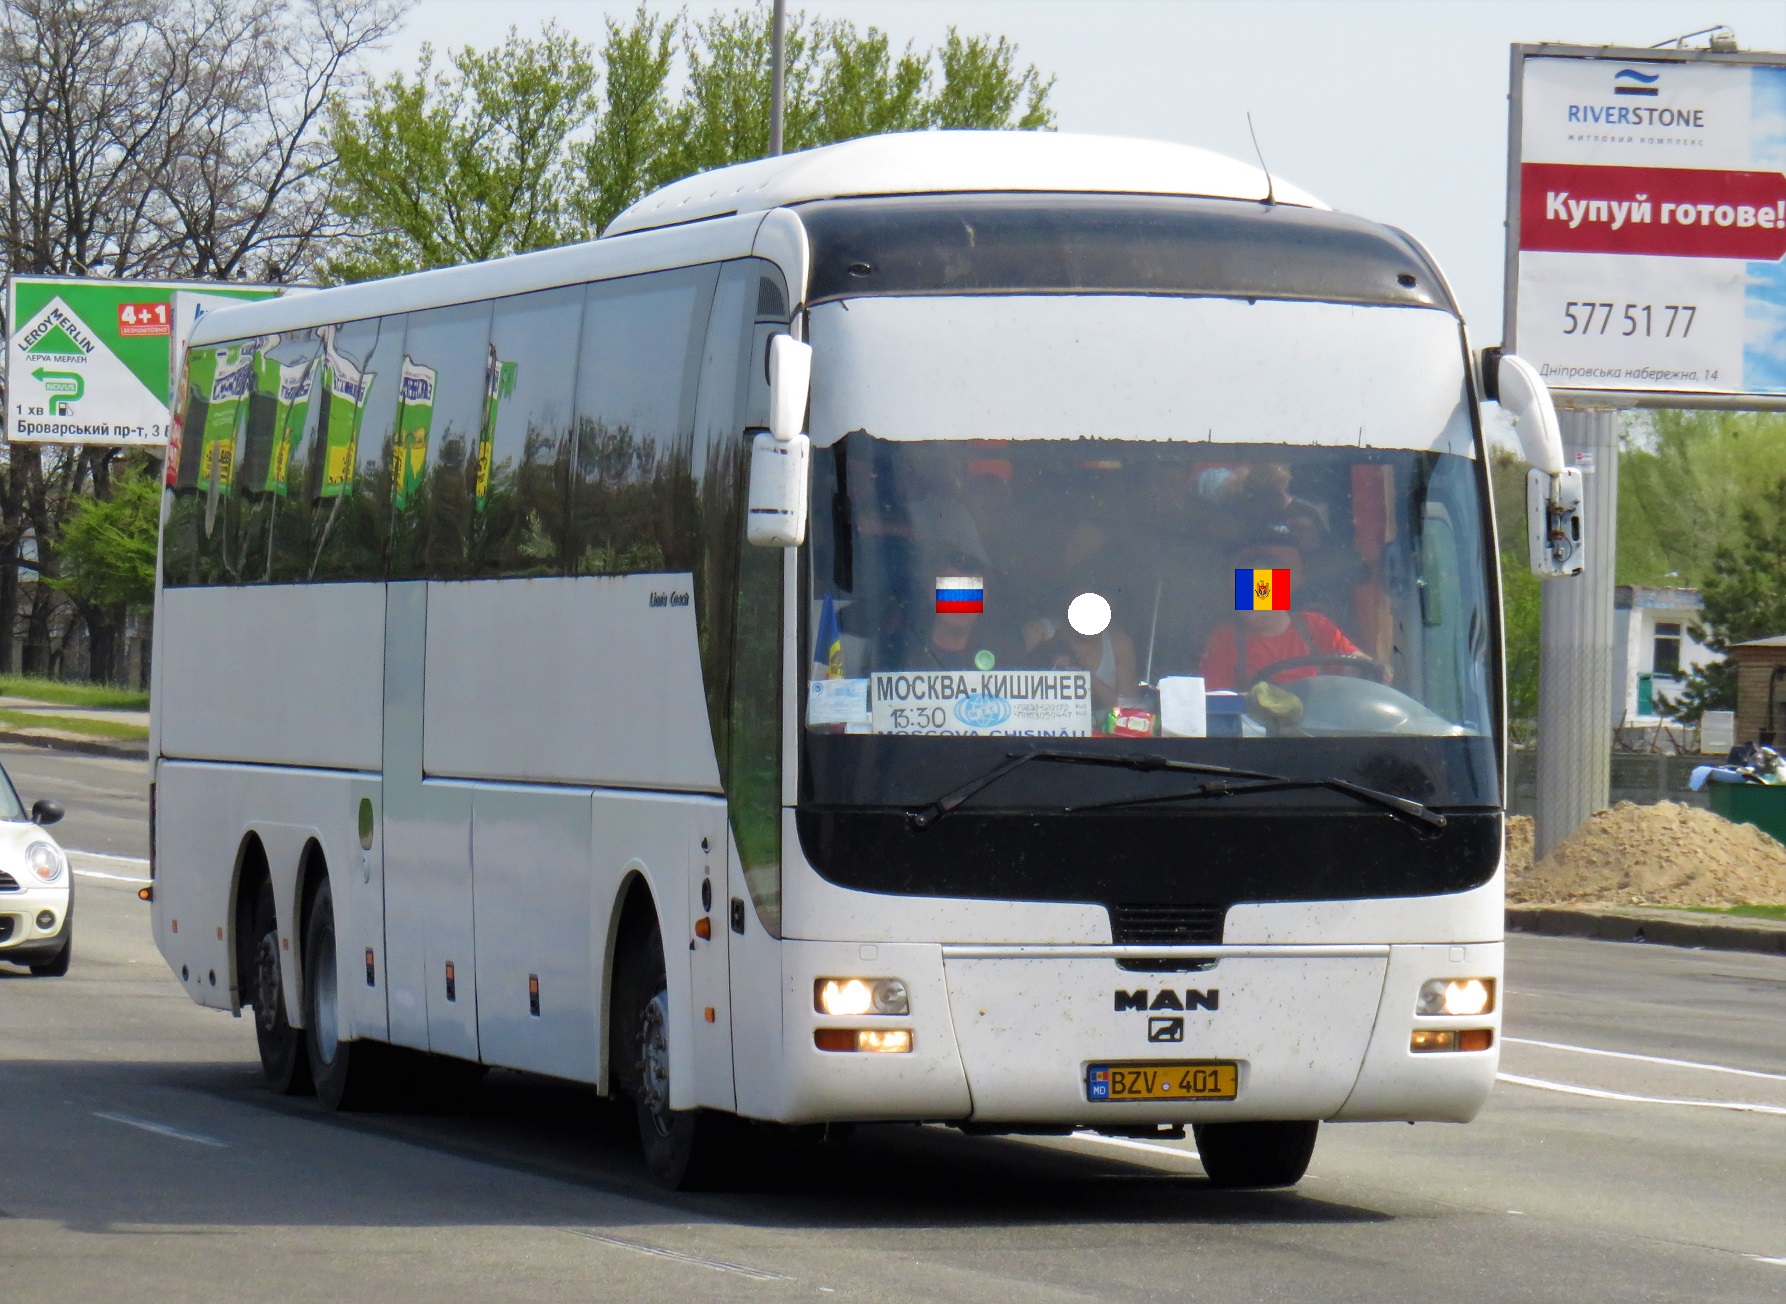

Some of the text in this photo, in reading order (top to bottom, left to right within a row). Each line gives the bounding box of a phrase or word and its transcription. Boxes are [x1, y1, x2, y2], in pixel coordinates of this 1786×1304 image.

[1567, 105, 1704, 128] RIVERSTONE
[1546, 191, 1786, 231] Купуй готове!
[121, 305, 167, 325] 4+1
[1563, 302, 1697, 338] 577 51 77
[17, 307, 95, 354] LEROY MERLIN
[25, 354, 87, 364] ЛЕРУА МЕРЛЕН
[1539, 363, 1719, 382] Дніпровська набережна, 14
[46, 383, 75, 391] NOVUS
[16, 404, 44, 416] 1 хв
[17, 419, 109, 438] Броварський
[114, 425, 148, 439] пр-т,
[152, 425, 160, 437] 3
[1114, 989, 1220, 1011] MAN
[1092, 1069, 1222, 1095] MD BZV 401
